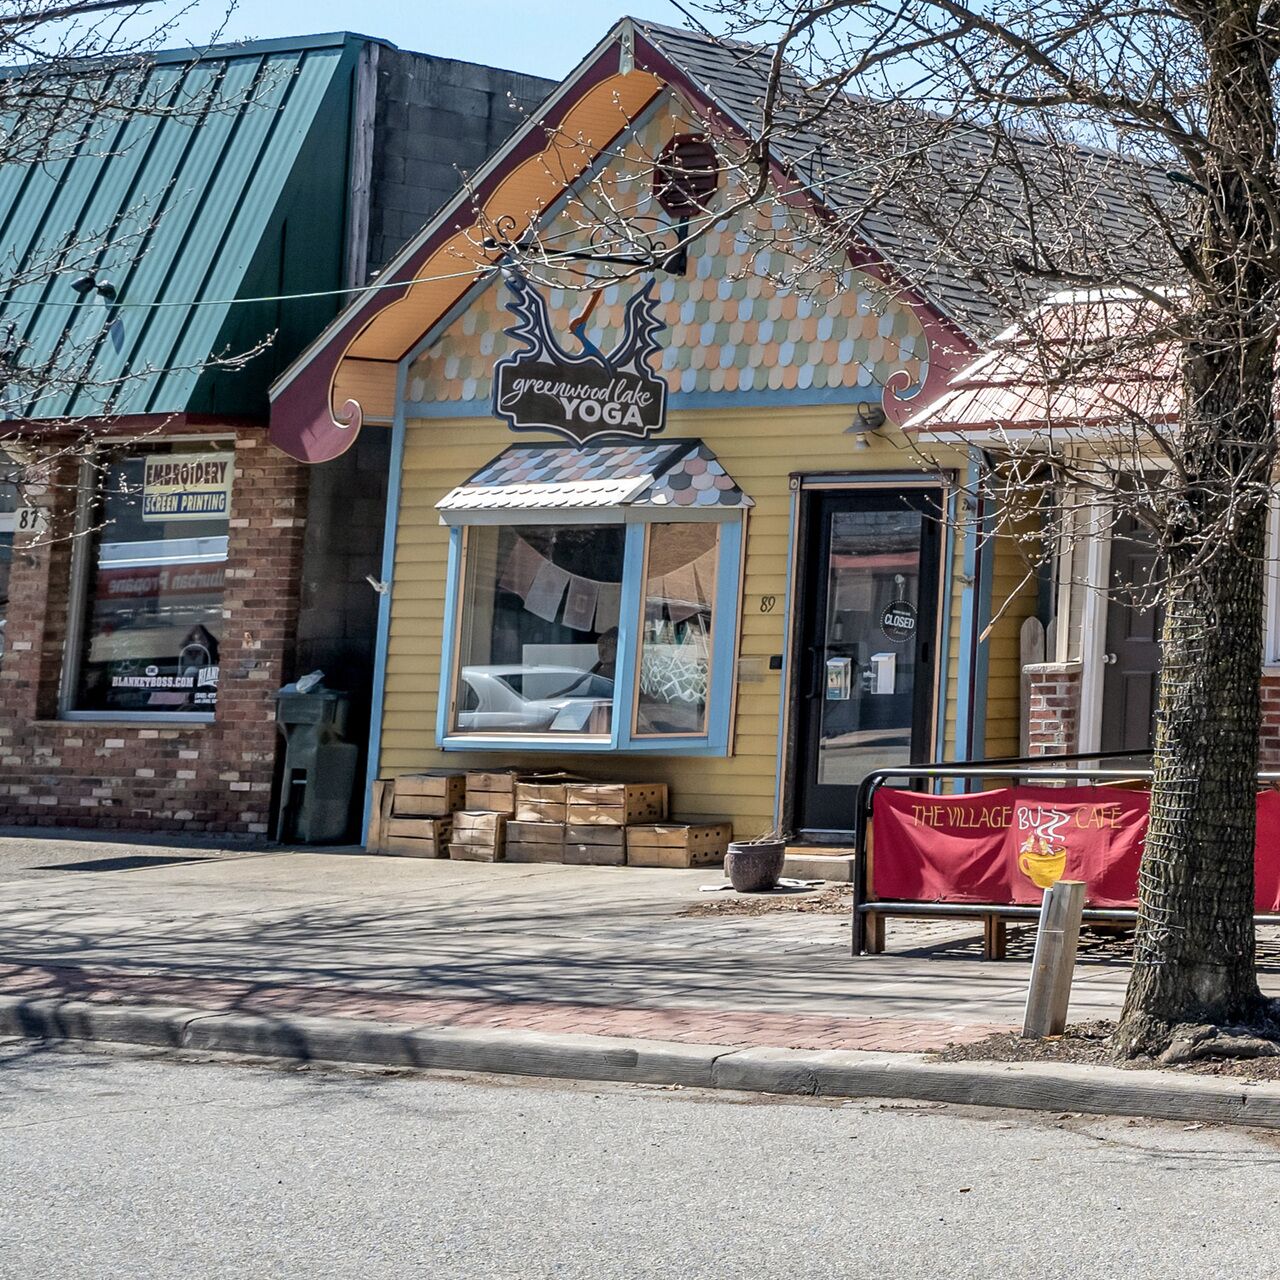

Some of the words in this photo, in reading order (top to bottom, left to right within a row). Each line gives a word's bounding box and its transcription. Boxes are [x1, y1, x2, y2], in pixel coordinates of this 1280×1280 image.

[501, 378, 614, 406] greenwood
[614, 378, 654, 408] lake
[559, 397, 644, 428] YOGA
[146, 461, 228, 486] EMBROIDERY
[145, 494, 179, 513] SCREEN
[180, 493, 226, 512] PRINTING
[19, 509, 38, 529] 87
[760, 596, 776, 613] 89
[884, 613, 915, 629] CLOSED
[912, 805, 944, 827] THE
[946, 806, 1013, 828] VILLAGE
